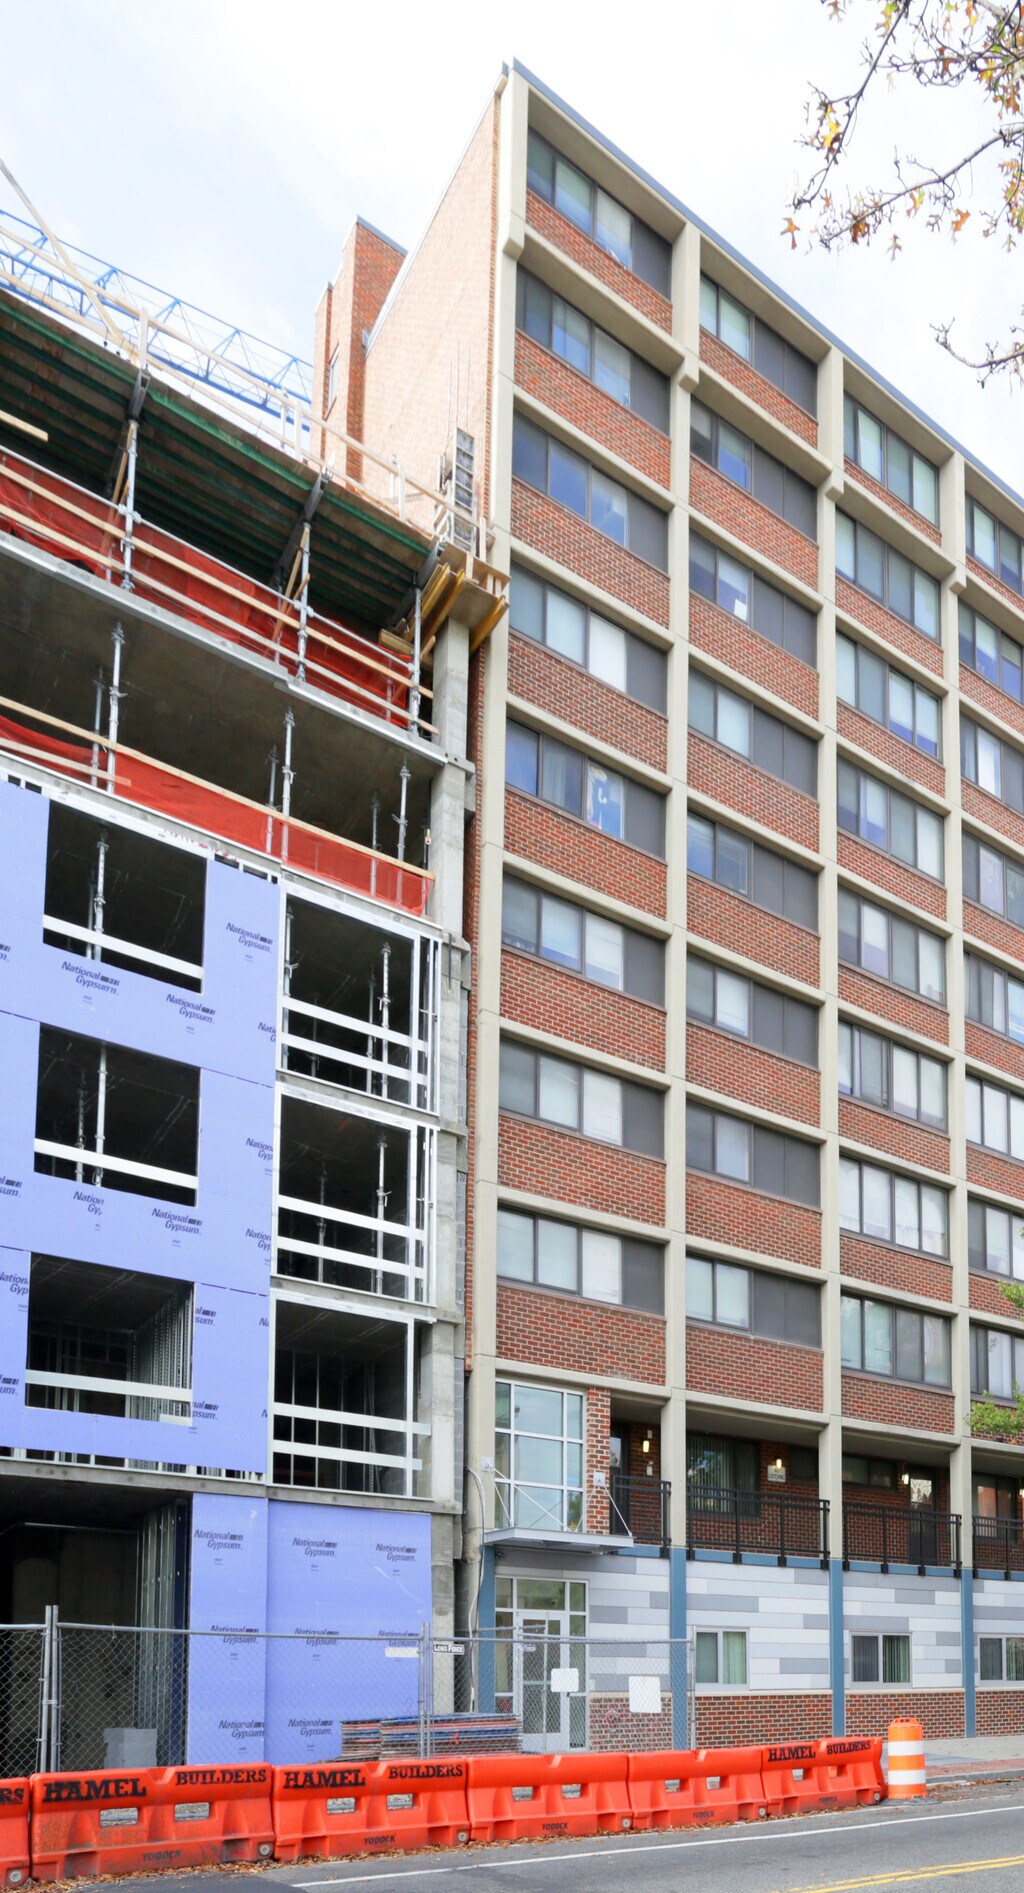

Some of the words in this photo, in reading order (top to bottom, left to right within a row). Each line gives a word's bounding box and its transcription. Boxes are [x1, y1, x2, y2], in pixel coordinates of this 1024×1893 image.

[225, 922, 261, 941] National
[61, 961, 101, 980] National
[166, 993, 203, 1011] National
[152, 1208, 189, 1223] National
[194, 1529, 230, 1541] National
[292, 1537, 325, 1548] National
[376, 1543, 406, 1553] National
[219, 1719, 254, 1729] National
[288, 1718, 321, 1728] National
[767, 1746, 816, 1762] HAMEL
[826, 1740, 871, 1755] BUILDERS
[283, 1769, 366, 1789] HAMEL
[388, 1764, 463, 1779] BUILDERS
[43, 1778, 147, 1802] HAMEL
[175, 1768, 267, 1786] BUILDERS
